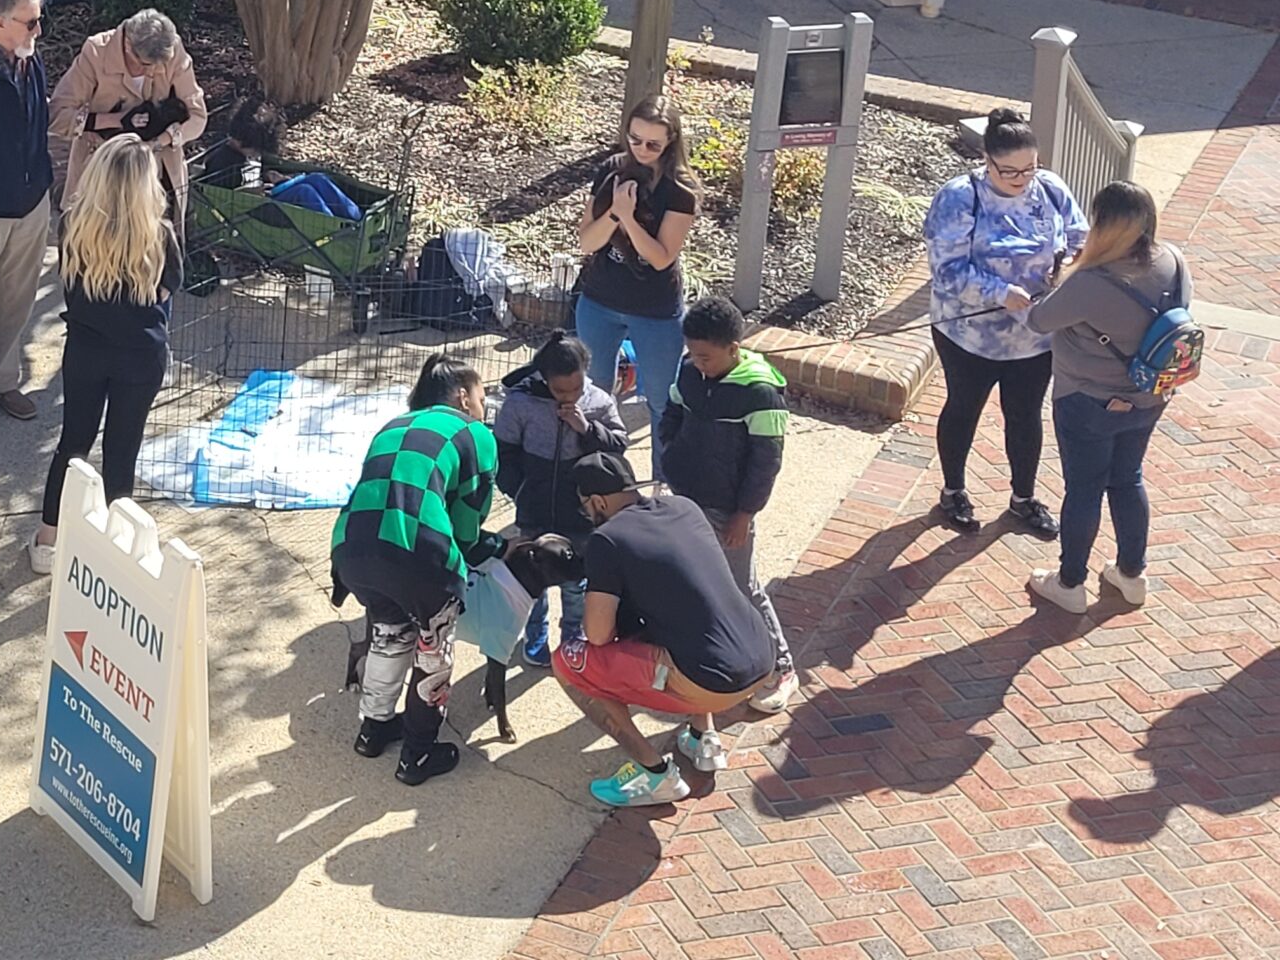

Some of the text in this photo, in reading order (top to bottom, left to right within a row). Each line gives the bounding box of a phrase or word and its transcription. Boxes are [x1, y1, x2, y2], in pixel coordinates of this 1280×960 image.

[67, 555, 164, 663] ADOPTION
[89, 644, 155, 723] EVENT
[62, 685, 143, 773] To The Rescue
[49, 736, 141, 842] 571-206-8704
[52, 775, 133, 865] www.totherescueinc.org
